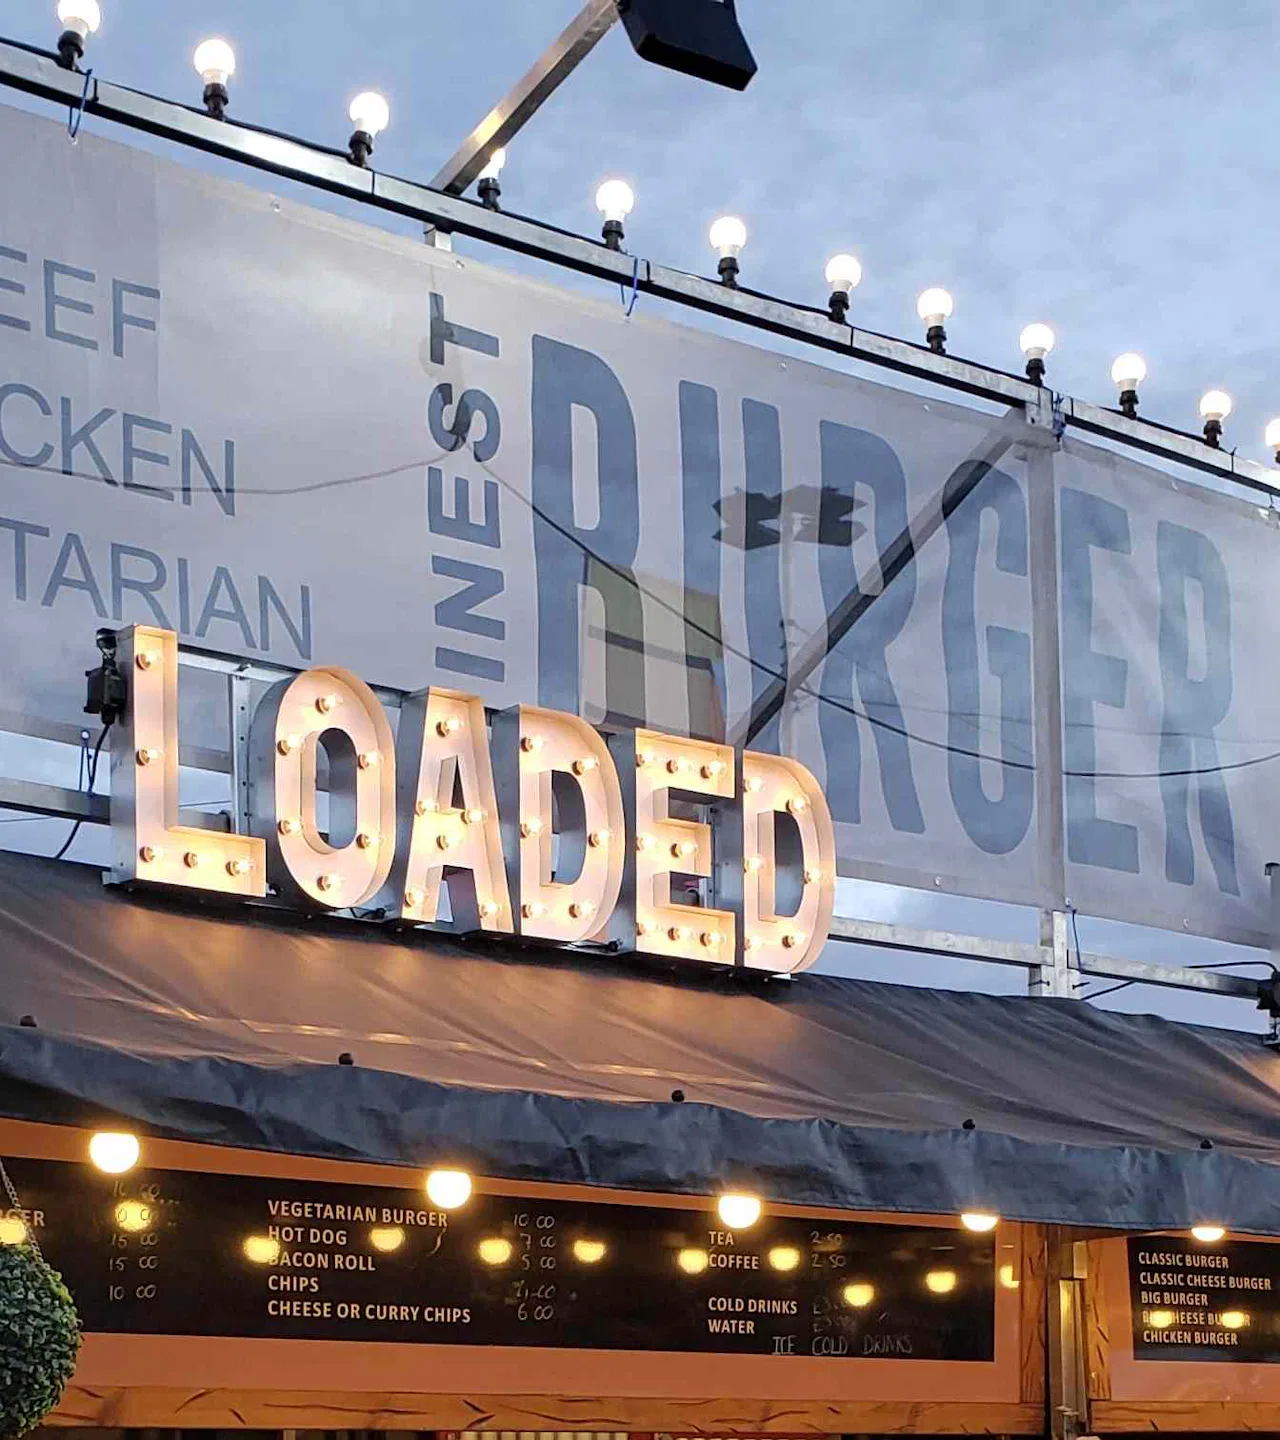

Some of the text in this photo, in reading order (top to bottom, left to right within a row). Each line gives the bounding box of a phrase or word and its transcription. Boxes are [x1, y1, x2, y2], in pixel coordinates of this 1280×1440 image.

[531, 335, 1241, 896] BURGER
[132, 624, 838, 977] LOADED
[268, 1199, 449, 1228] VEGETARIAN BURGER
[268, 1225, 347, 1246] HOT DOG
[708, 1230, 735, 1247] TEA
[269, 1251, 376, 1272] BACON ROLL
[708, 1253, 760, 1271] COFFEE
[1138, 1251, 1230, 1270] CLASSIC BURGER
[268, 1275, 319, 1293] CHIPS
[1139, 1271, 1272, 1291] CLASSIC CHEESE BURGER
[708, 1296, 798, 1315] COLD DRINKS
[1141, 1290, 1209, 1307] BIG BURGER
[267, 1300, 471, 1324] CHEESE OR CURRY CHIPS
[708, 1318, 755, 1335] WATER
[811, 1336, 848, 1356] COLD
[1143, 1329, 1238, 1346] CHICKEN BURGER
